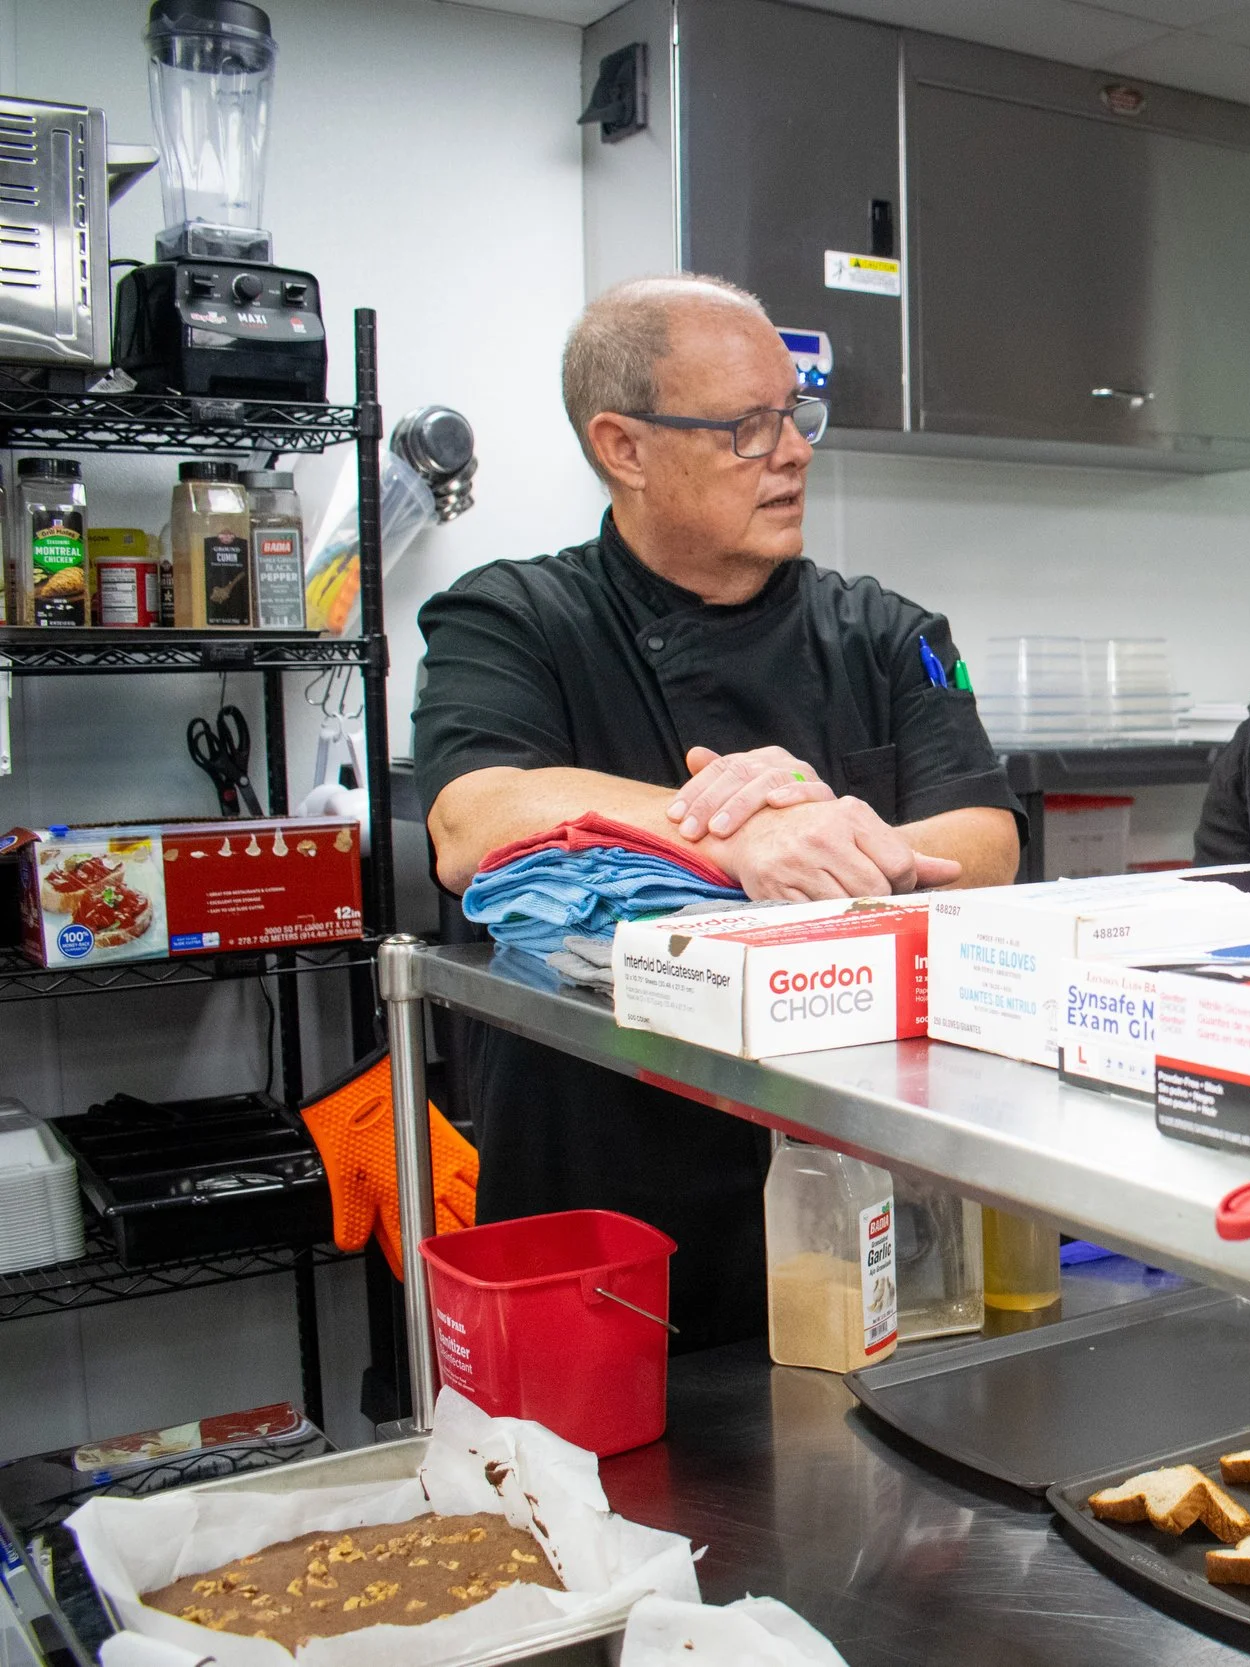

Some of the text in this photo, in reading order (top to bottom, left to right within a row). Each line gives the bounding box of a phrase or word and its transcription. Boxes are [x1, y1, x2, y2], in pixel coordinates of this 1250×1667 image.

[238, 312, 267, 325] MAXI
[35, 546, 81, 556] MONTREAL
[263, 541, 292, 553] BADIA
[44, 555, 73, 564] CHICKEN
[216, 552, 238, 562] CUMIN
[265, 563, 293, 572] BLACK
[260, 572, 298, 582] PEPPER
[935, 903, 961, 916] 488287
[63, 931, 89, 943] 100%
[270, 932, 299, 943] METERS
[1092, 926, 1131, 940] 488287
[960, 943, 1037, 972] NITRILE GLOVES
[624, 953, 731, 988] Interfold Delicatessen Paper
[769, 963, 873, 995] Gordon
[959, 986, 993, 1006] GUANTES
[995, 994, 1004, 1008] DE
[1006, 997, 1037, 1016] NITRILO
[1068, 985, 1136, 1016] Synsafe
[1067, 1006, 1119, 1035] Exam
[1078, 1046, 1087, 1065] L
[870, 1213, 889, 1235] BADIA
[868, 1243, 891, 1267] Garlic
